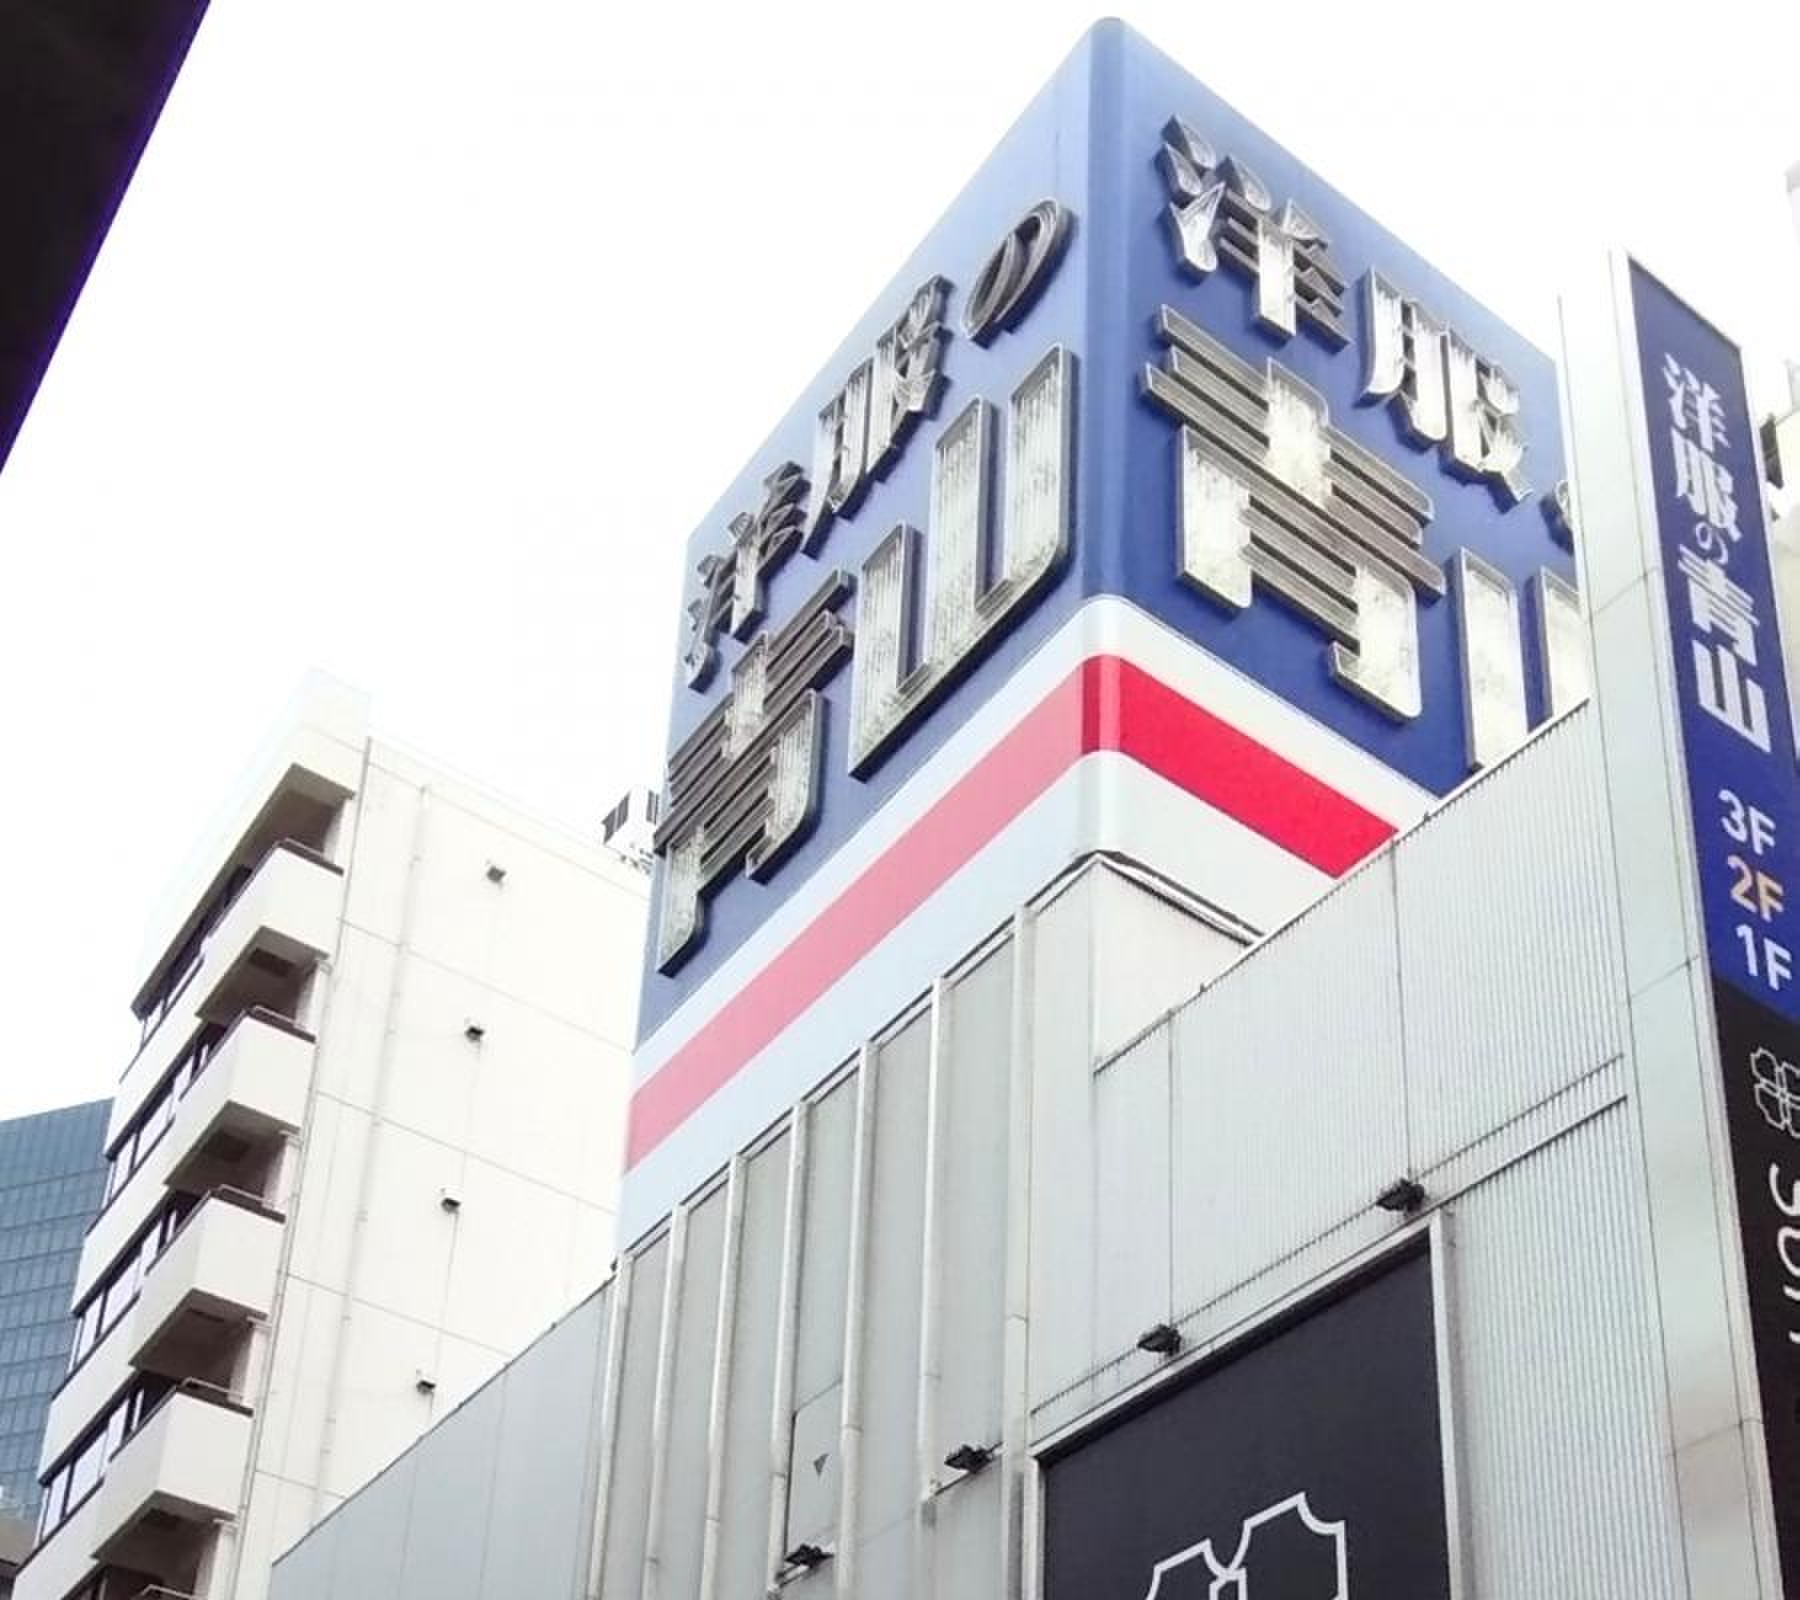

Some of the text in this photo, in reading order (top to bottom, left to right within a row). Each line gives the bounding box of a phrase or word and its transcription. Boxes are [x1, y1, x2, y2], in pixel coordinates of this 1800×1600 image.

[1152, 113, 1576, 555] 洋服
[653, 342, 1078, 978] 青山
[1662, 352, 1772, 754] 洋服の青山
[1720, 788, 1776, 856] 3F
[1727, 855, 1784, 921] 2F
[1736, 924, 1793, 991] 1F
